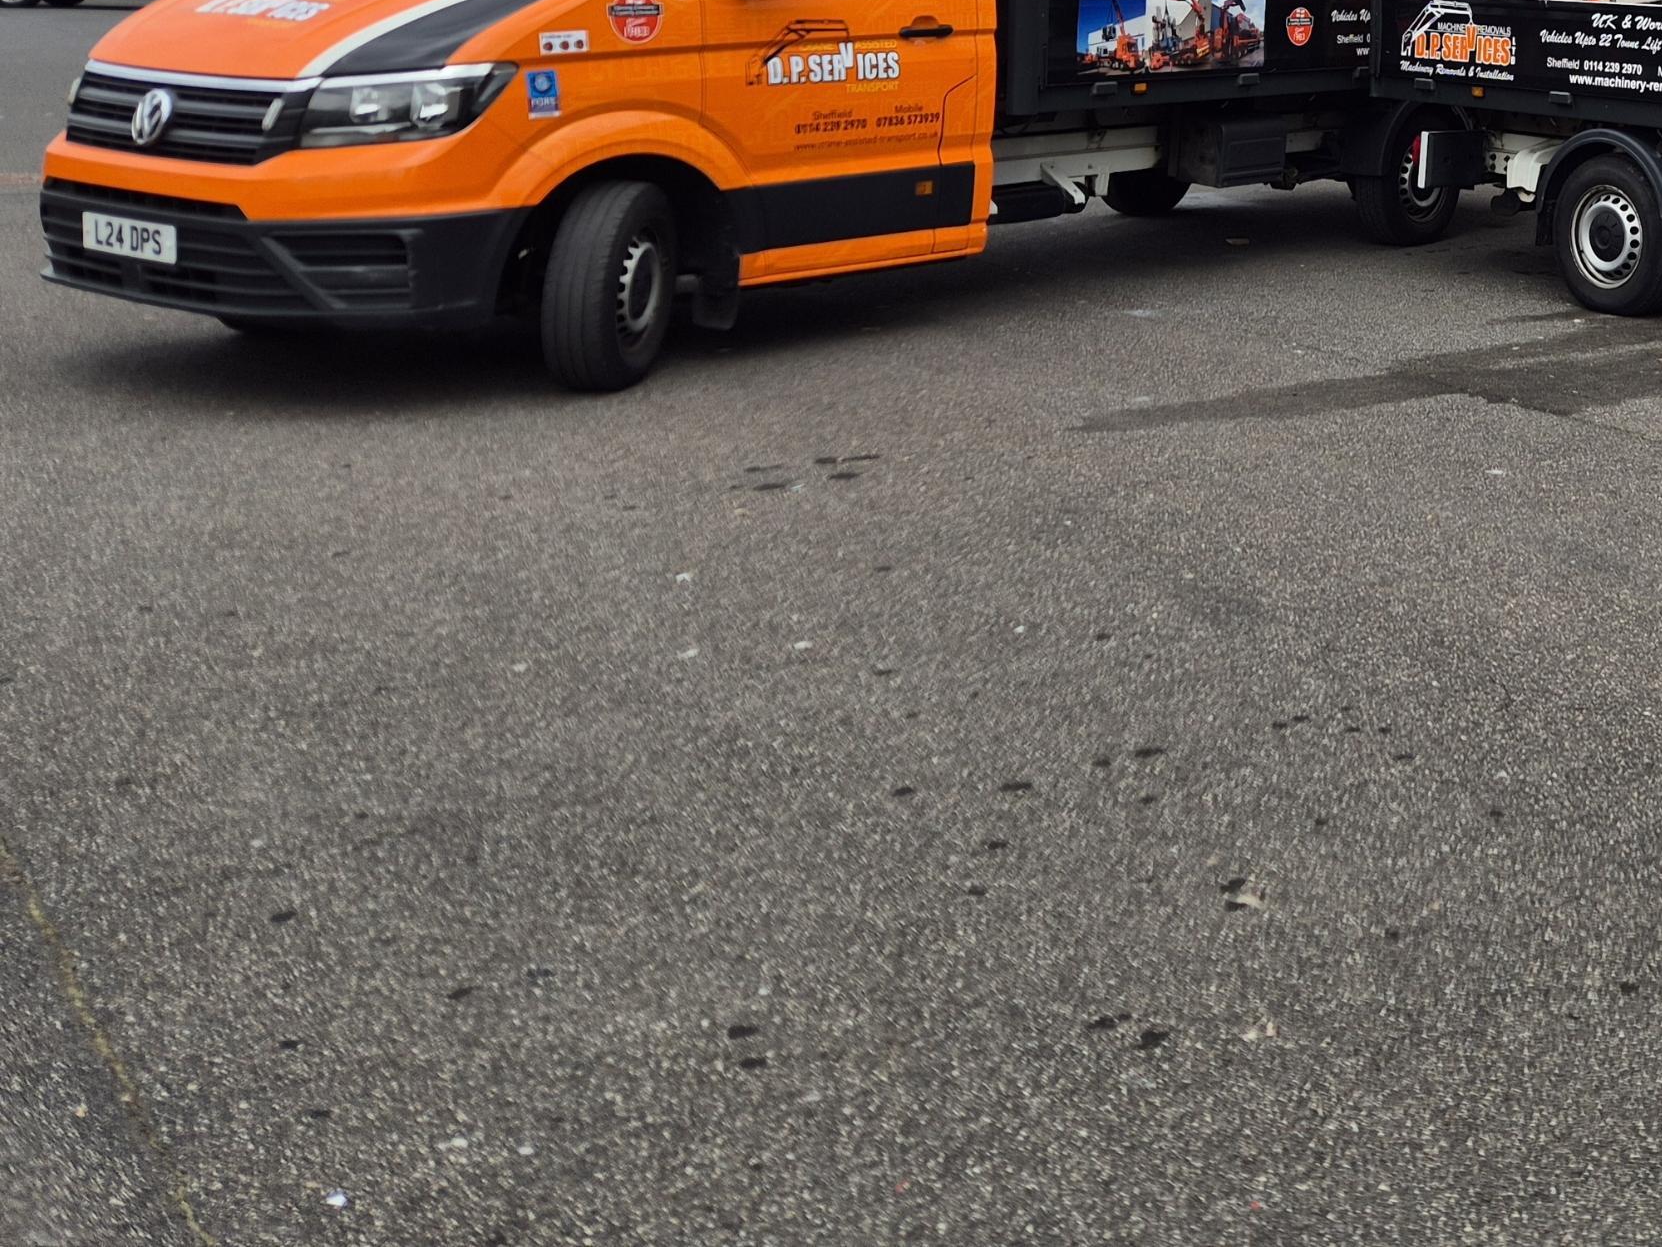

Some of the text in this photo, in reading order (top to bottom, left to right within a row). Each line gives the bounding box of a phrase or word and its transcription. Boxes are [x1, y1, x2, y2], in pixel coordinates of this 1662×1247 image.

[1330, 8, 1371, 24] Vehicles Up
[1591, 13, 1618, 30] UK
[1621, 14, 1632, 29] &
[1437, 22, 1512, 37] MACHINE REMOVALS
[1336, 34, 1364, 44] Sheffield
[1539, 29, 1573, 44] Vehicles
[1574, 31, 1597, 47] Upto
[1598, 34, 1612, 47] 22
[1614, 34, 1639, 50] Tonne
[1641, 37, 1662, 55] Lift
[1400, 60, 1514, 81] Machinery Removals & Installation
[1546, 57, 1643, 75] Sheffield 0114 239 2970
[846, 81, 899, 93] TRANSPORT
[894, 104, 923, 114] Mobile
[906, 112, 940, 125] 573939
[95, 219, 162, 255] L24 DPS
